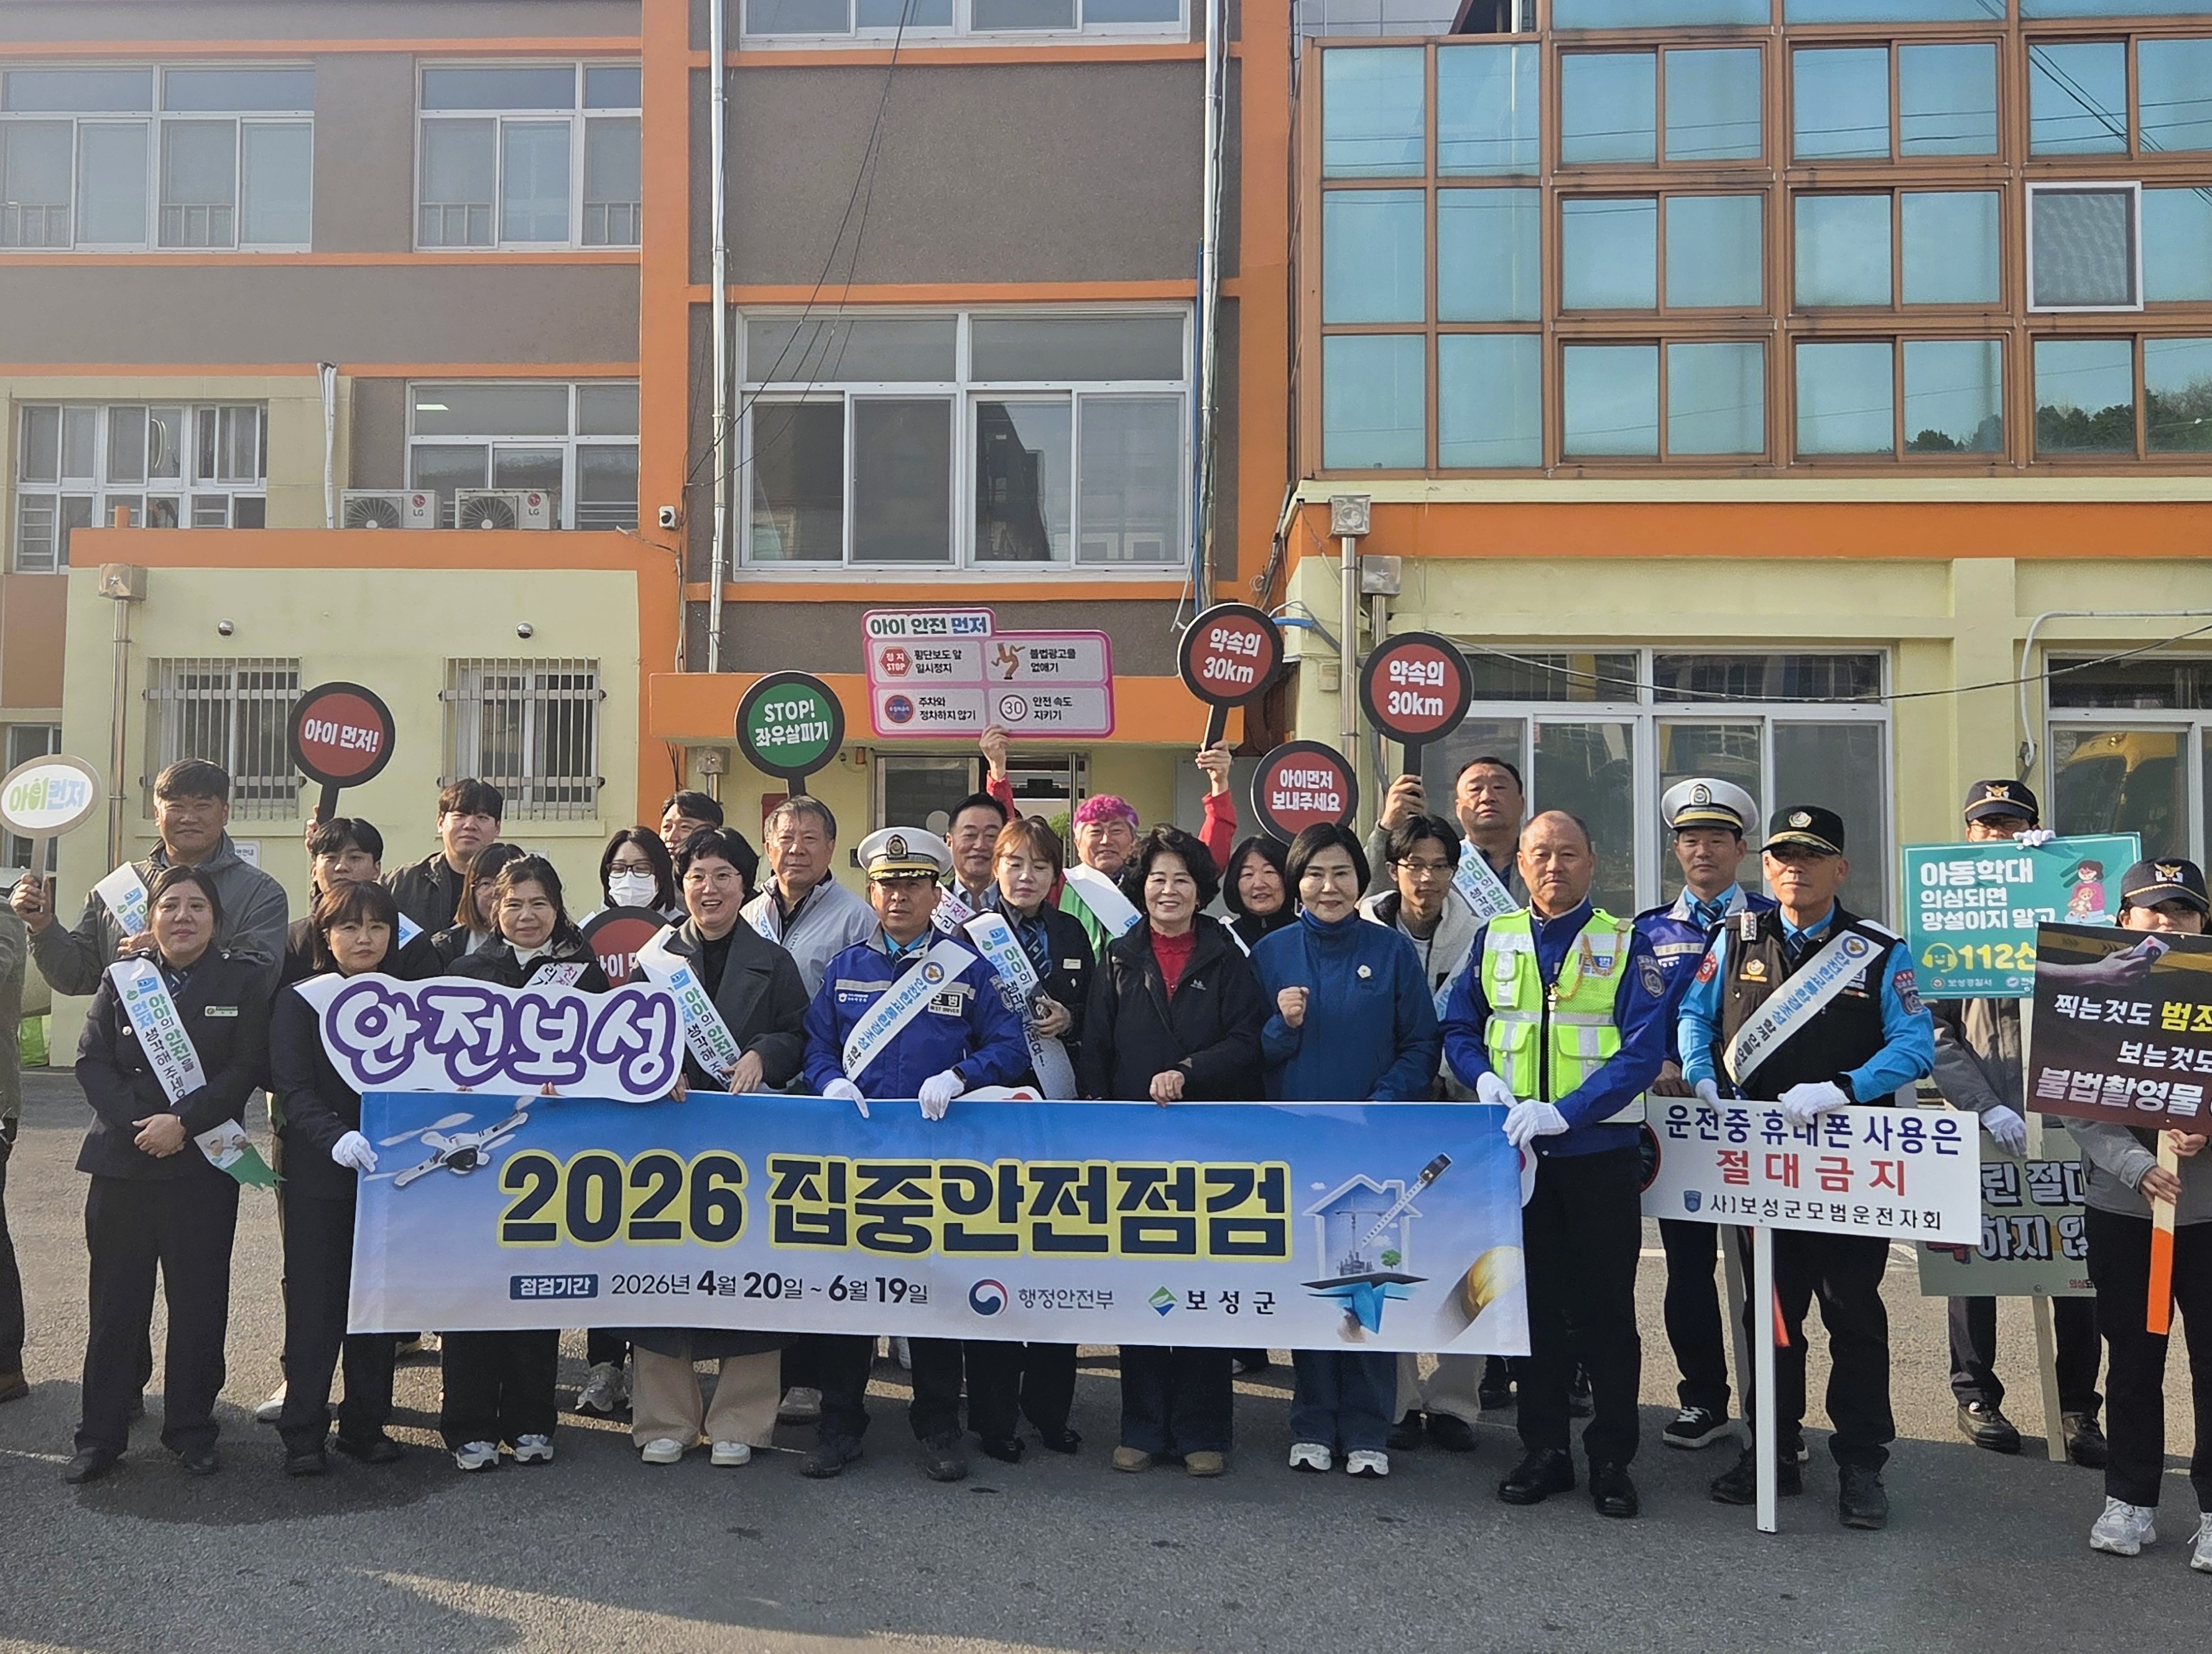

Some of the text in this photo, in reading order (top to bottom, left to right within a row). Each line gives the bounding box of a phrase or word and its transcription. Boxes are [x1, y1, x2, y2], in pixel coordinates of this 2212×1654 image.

[529, 508, 540, 516] LG
[871, 616, 988, 635] 아이 안전 먼저
[914, 649, 962, 660] 횡단보도 앞
[1210, 628, 1261, 657] 약속의
[915, 663, 952, 674] 일시정지
[1030, 662, 1058, 672] 없애기
[1203, 656, 1254, 684] 30km
[1389, 660, 1445, 687] 약속의
[764, 699, 815, 723] STOP!
[919, 697, 945, 707] 주차와
[1004, 701, 1022, 714] 30
[1033, 697, 1073, 707] 안전 속도
[1034, 710, 1062, 720] 지키기
[1387, 690, 1443, 716] 30km
[920, 710, 976, 721] 정차하지 않기
[305, 718, 379, 752] 아이 먼저!
[755, 720, 829, 746] 좌우살피기
[1279, 769, 1333, 789] 아이먼저
[1272, 791, 1341, 812] 보내주세요
[1465, 856, 1514, 913] 아이의 안전
[1920, 858, 2034, 886] 아동학대
[1469, 887, 1496, 917] 생각해
[1920, 887, 2008, 909] 의심되면
[1922, 908, 2056, 932] 망설이지 말고
[1004, 946, 1032, 985] 아이의
[685, 987, 715, 1026] 아이의
[2054, 994, 2153, 1026] 찍는것도
[131, 1000, 155, 1029] 먼저
[144, 1027, 172, 1066] 생각해
[149, 993, 195, 1072] 아이의 안전을
[331, 985, 672, 1089] 안전보성
[687, 1023, 716, 1062] 생각해
[1756, 1018, 1777, 1043] 함께
[846, 1045, 863, 1068] 함께
[2036, 1067, 2203, 1117] 불법촬영물
[1665, 1105, 1752, 1143] 운전중
[1863, 1115, 1962, 1156] 사용은
[501, 1153, 1287, 1258] 2026 집중안전점검
[520, 1277, 591, 1296] 점검기간
[612, 1273, 691, 1295] 2026년
[696, 1270, 737, 1296] 4월
[744, 1272, 803, 1299] 20일
[828, 1275, 868, 1303] 6월
[876, 1276, 928, 1305] 19일
[1018, 1287, 1114, 1311] 행정안전부
